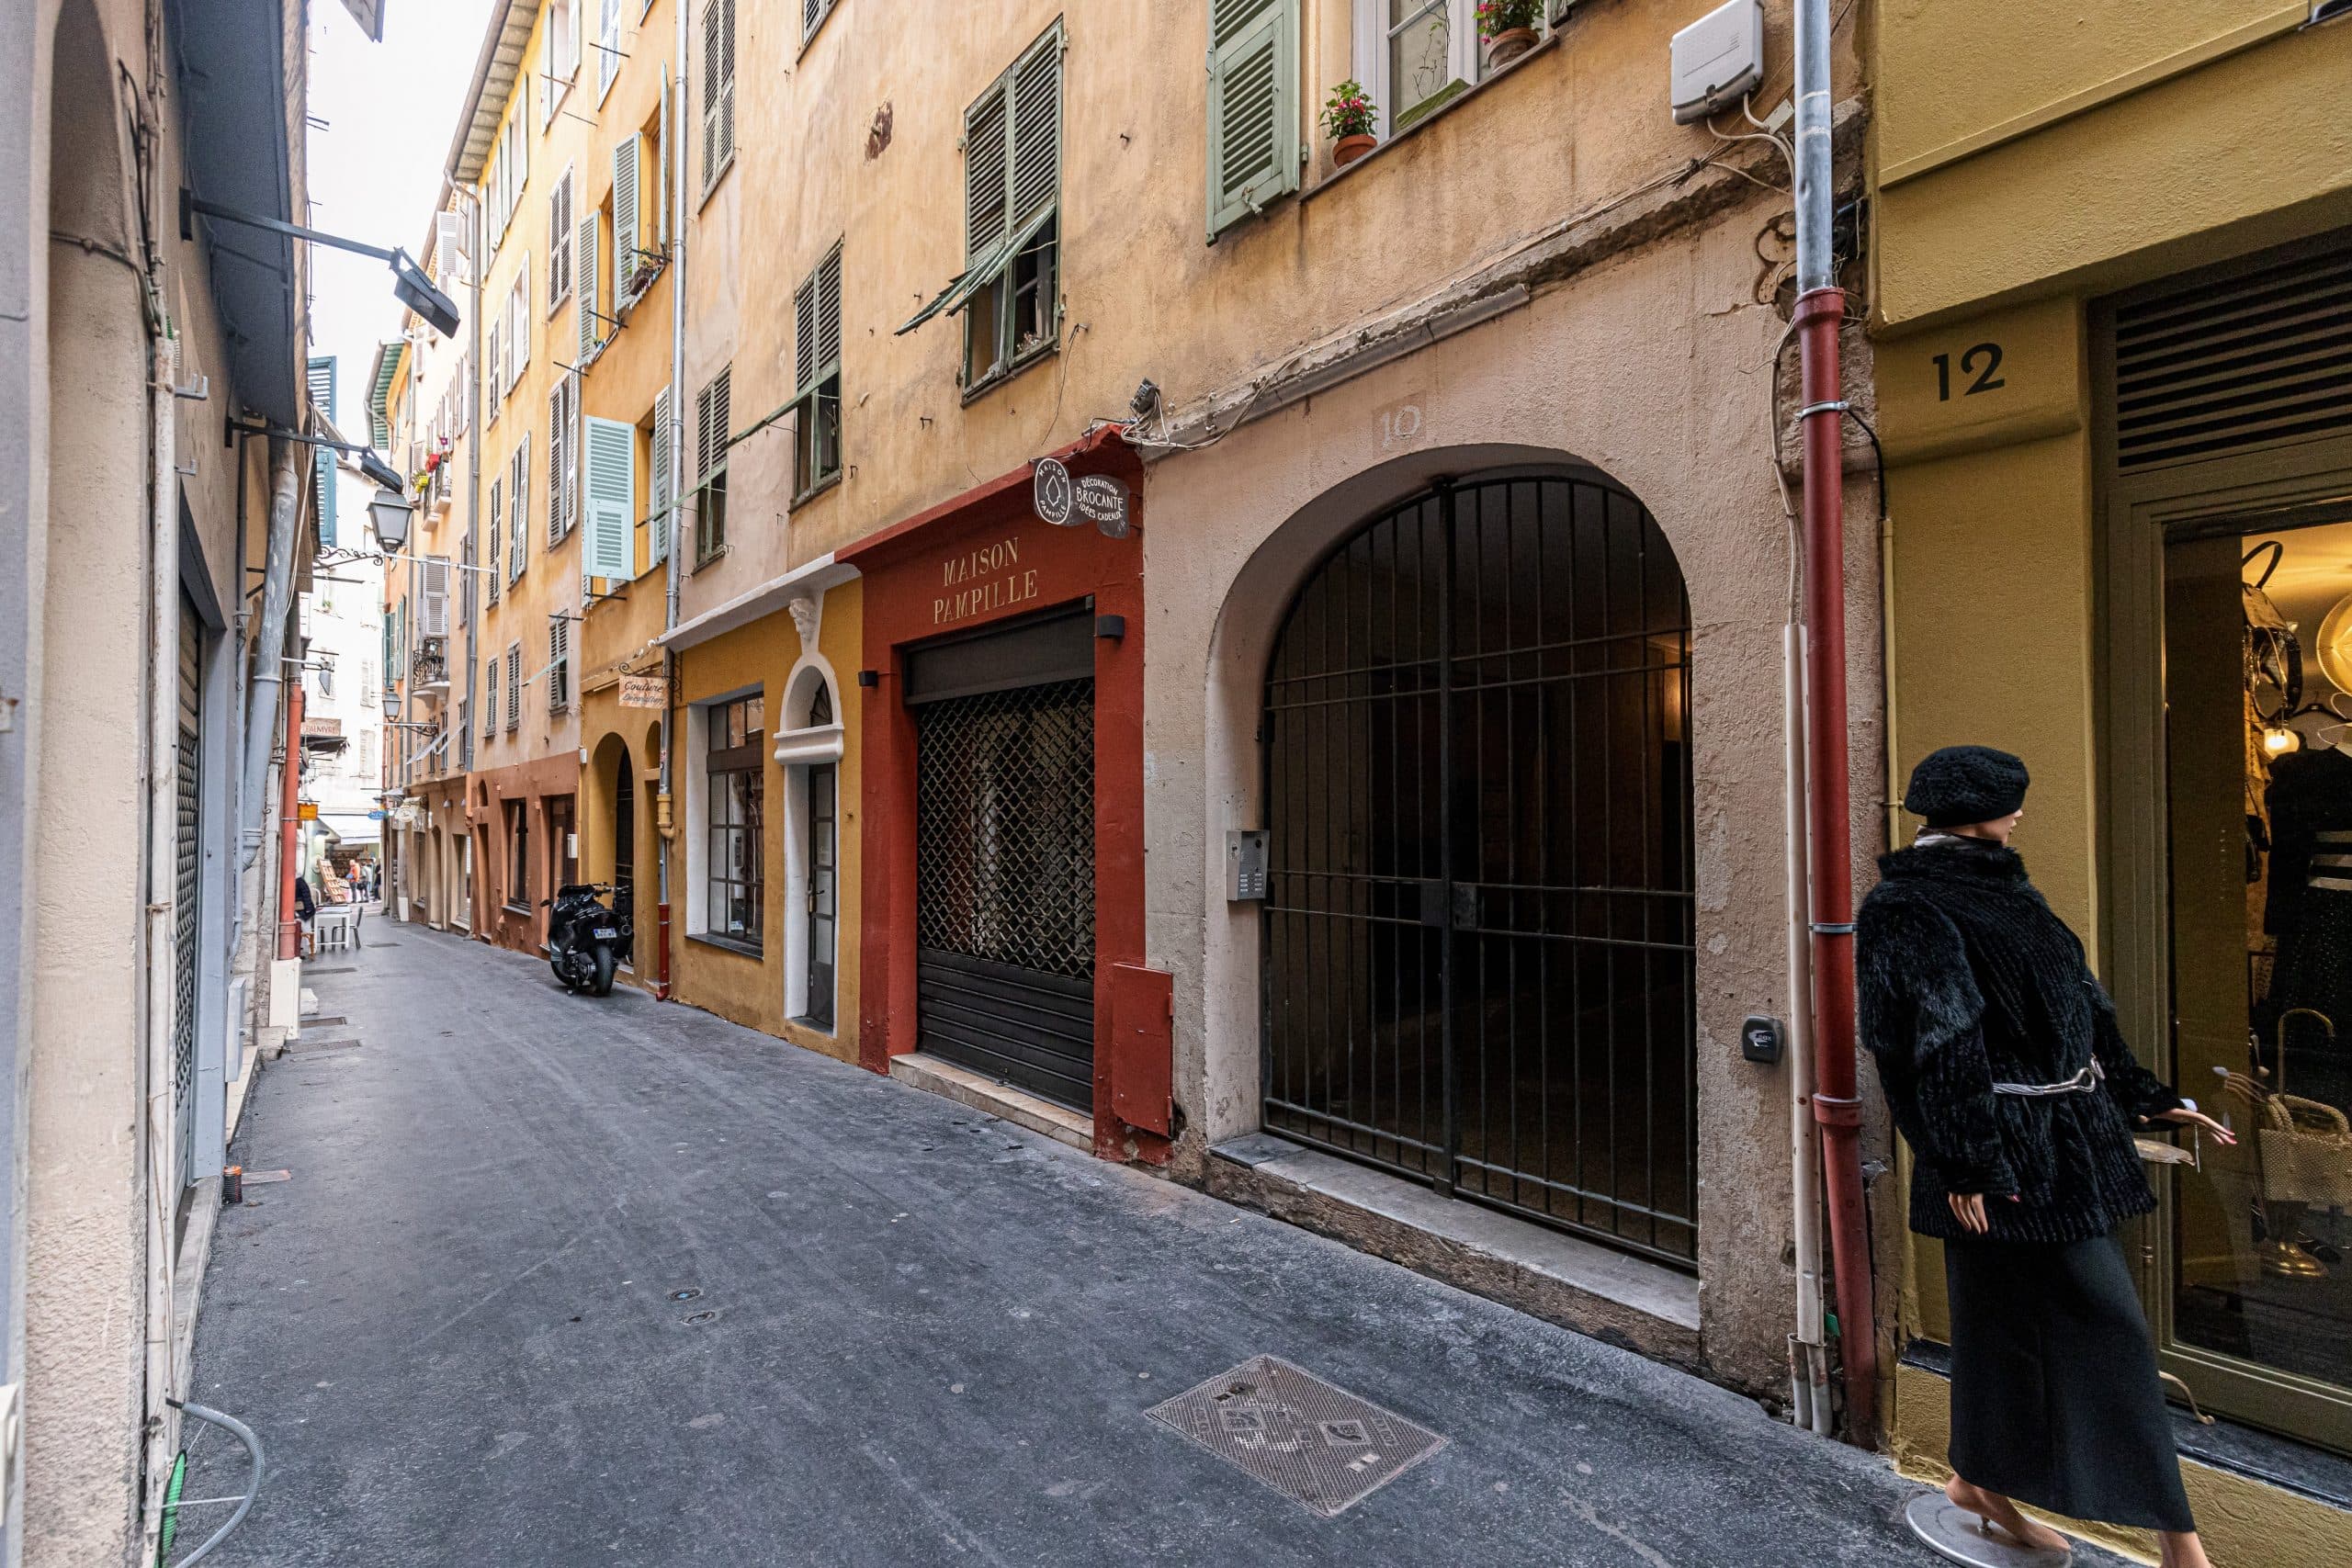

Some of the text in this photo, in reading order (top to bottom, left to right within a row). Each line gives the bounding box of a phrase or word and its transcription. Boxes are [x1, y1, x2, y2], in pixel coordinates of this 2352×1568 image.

[1932, 343, 2005, 401] 12
[1038, 463, 1067, 483] MAISON
[1039, 500, 1067, 518] PAMPILLE
[1076, 487, 1124, 512] BROCANTE
[1097, 511, 1122, 521] CADEAUX
[944, 536, 1019, 587] MAISON
[933, 570, 1037, 625] PAMPILLE
[624, 681, 663, 694] Couture
